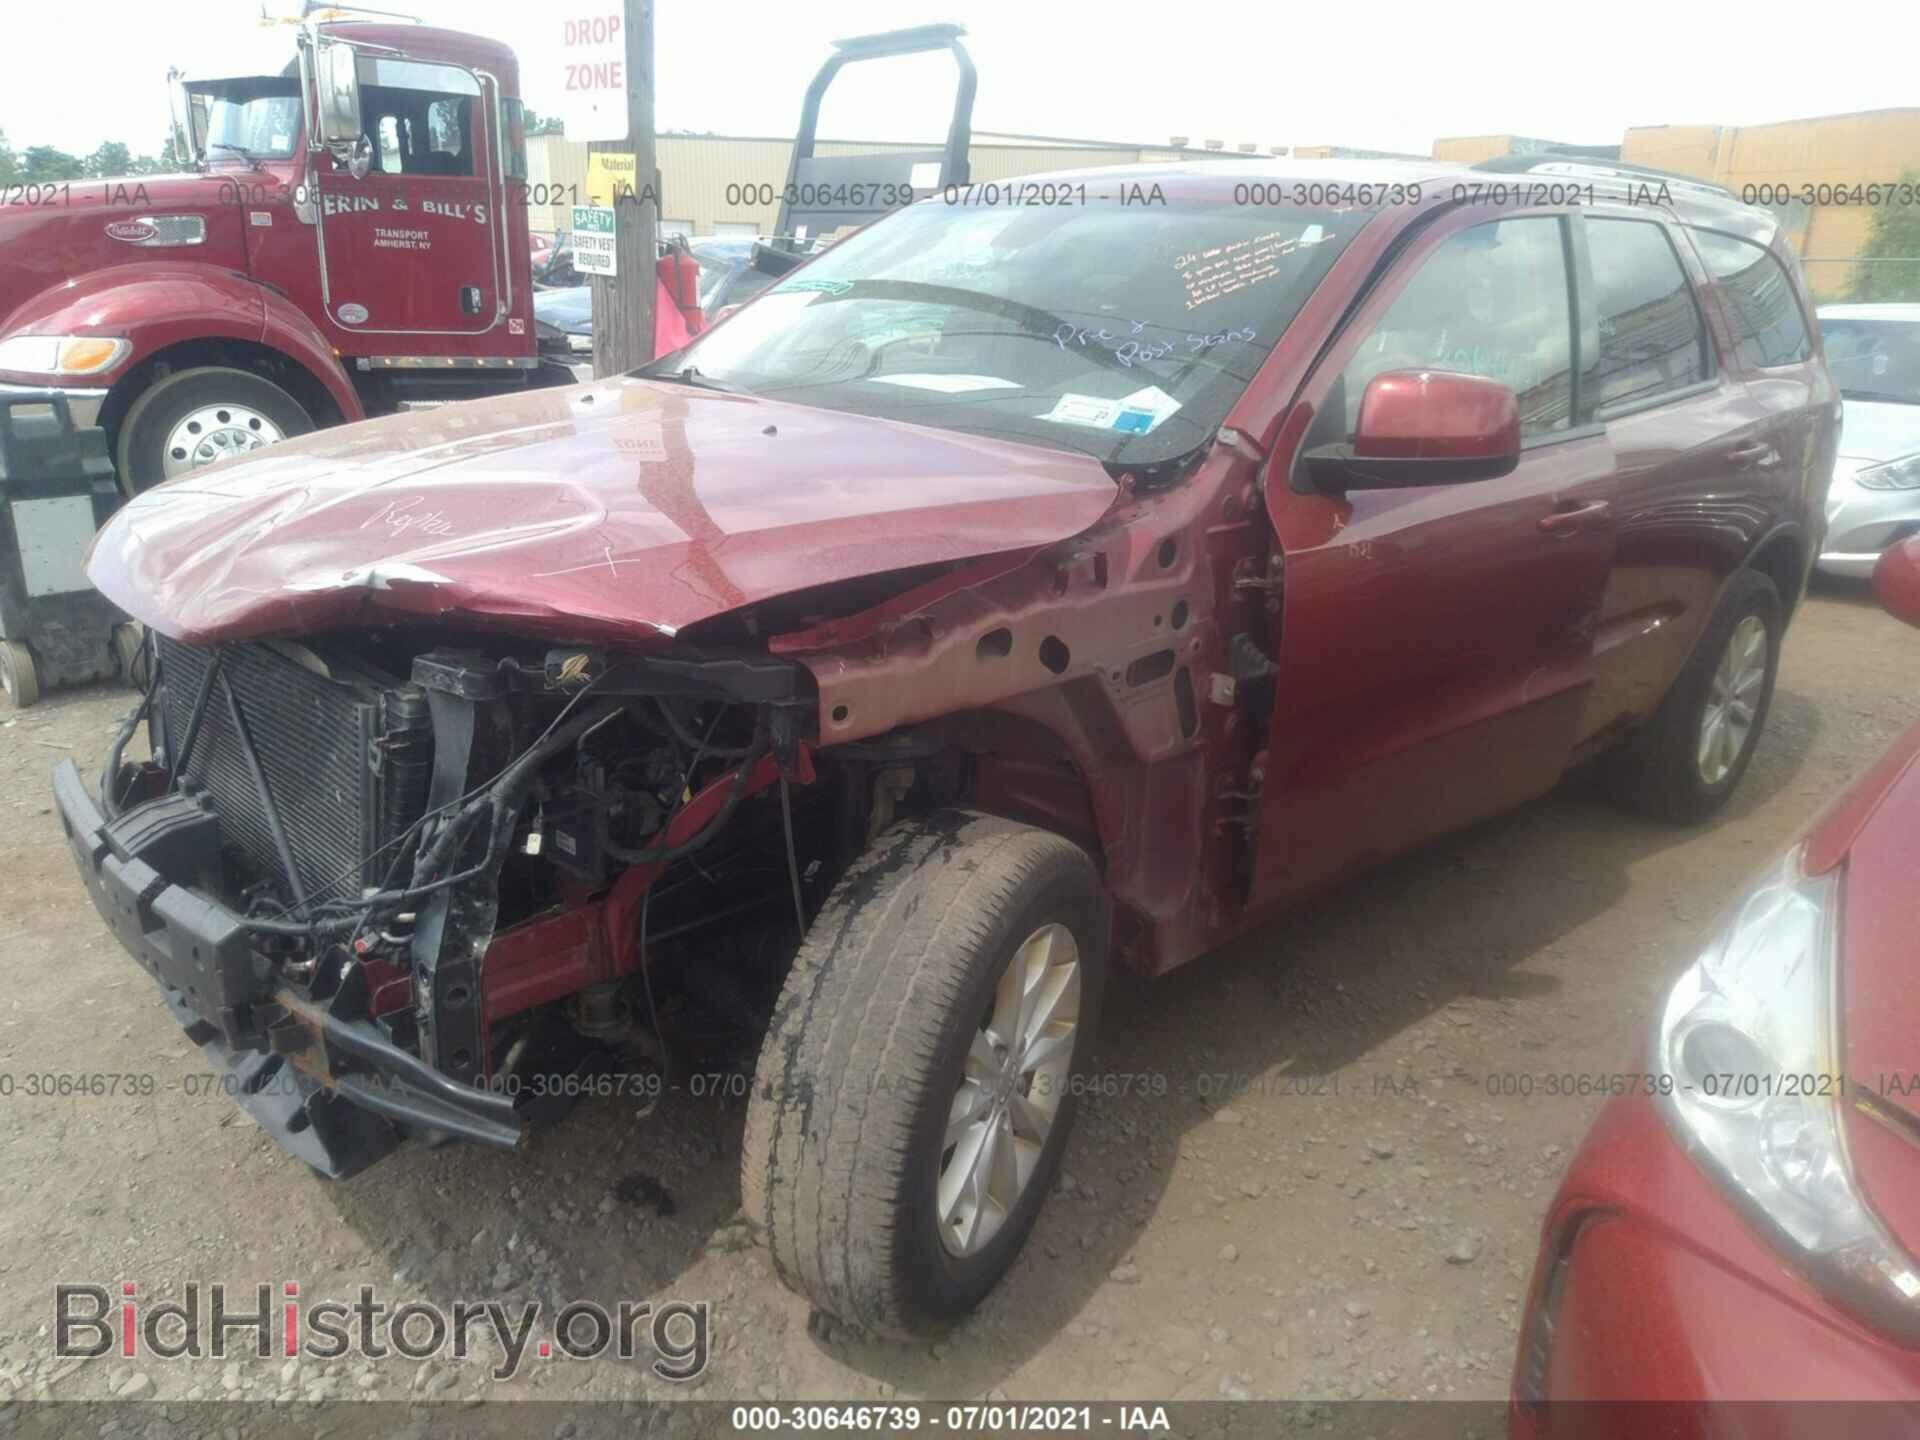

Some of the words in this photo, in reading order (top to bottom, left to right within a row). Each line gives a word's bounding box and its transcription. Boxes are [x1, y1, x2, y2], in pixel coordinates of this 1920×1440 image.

[564, 15, 621, 46] DROP
[565, 61, 622, 90] ZONE
[323, 195, 379, 216] ERIN
[392, 198, 408, 211] &
[422, 200, 487, 225] BILL'S
[575, 211, 612, 226] SAFETY
[374, 228, 429, 240] TRANSPORT
[575, 235, 597, 249] SAFETY
[599, 237, 615, 251] VEST
[578, 252, 610, 268] REQUIRED
[1053, 323, 1112, 350] Pre
